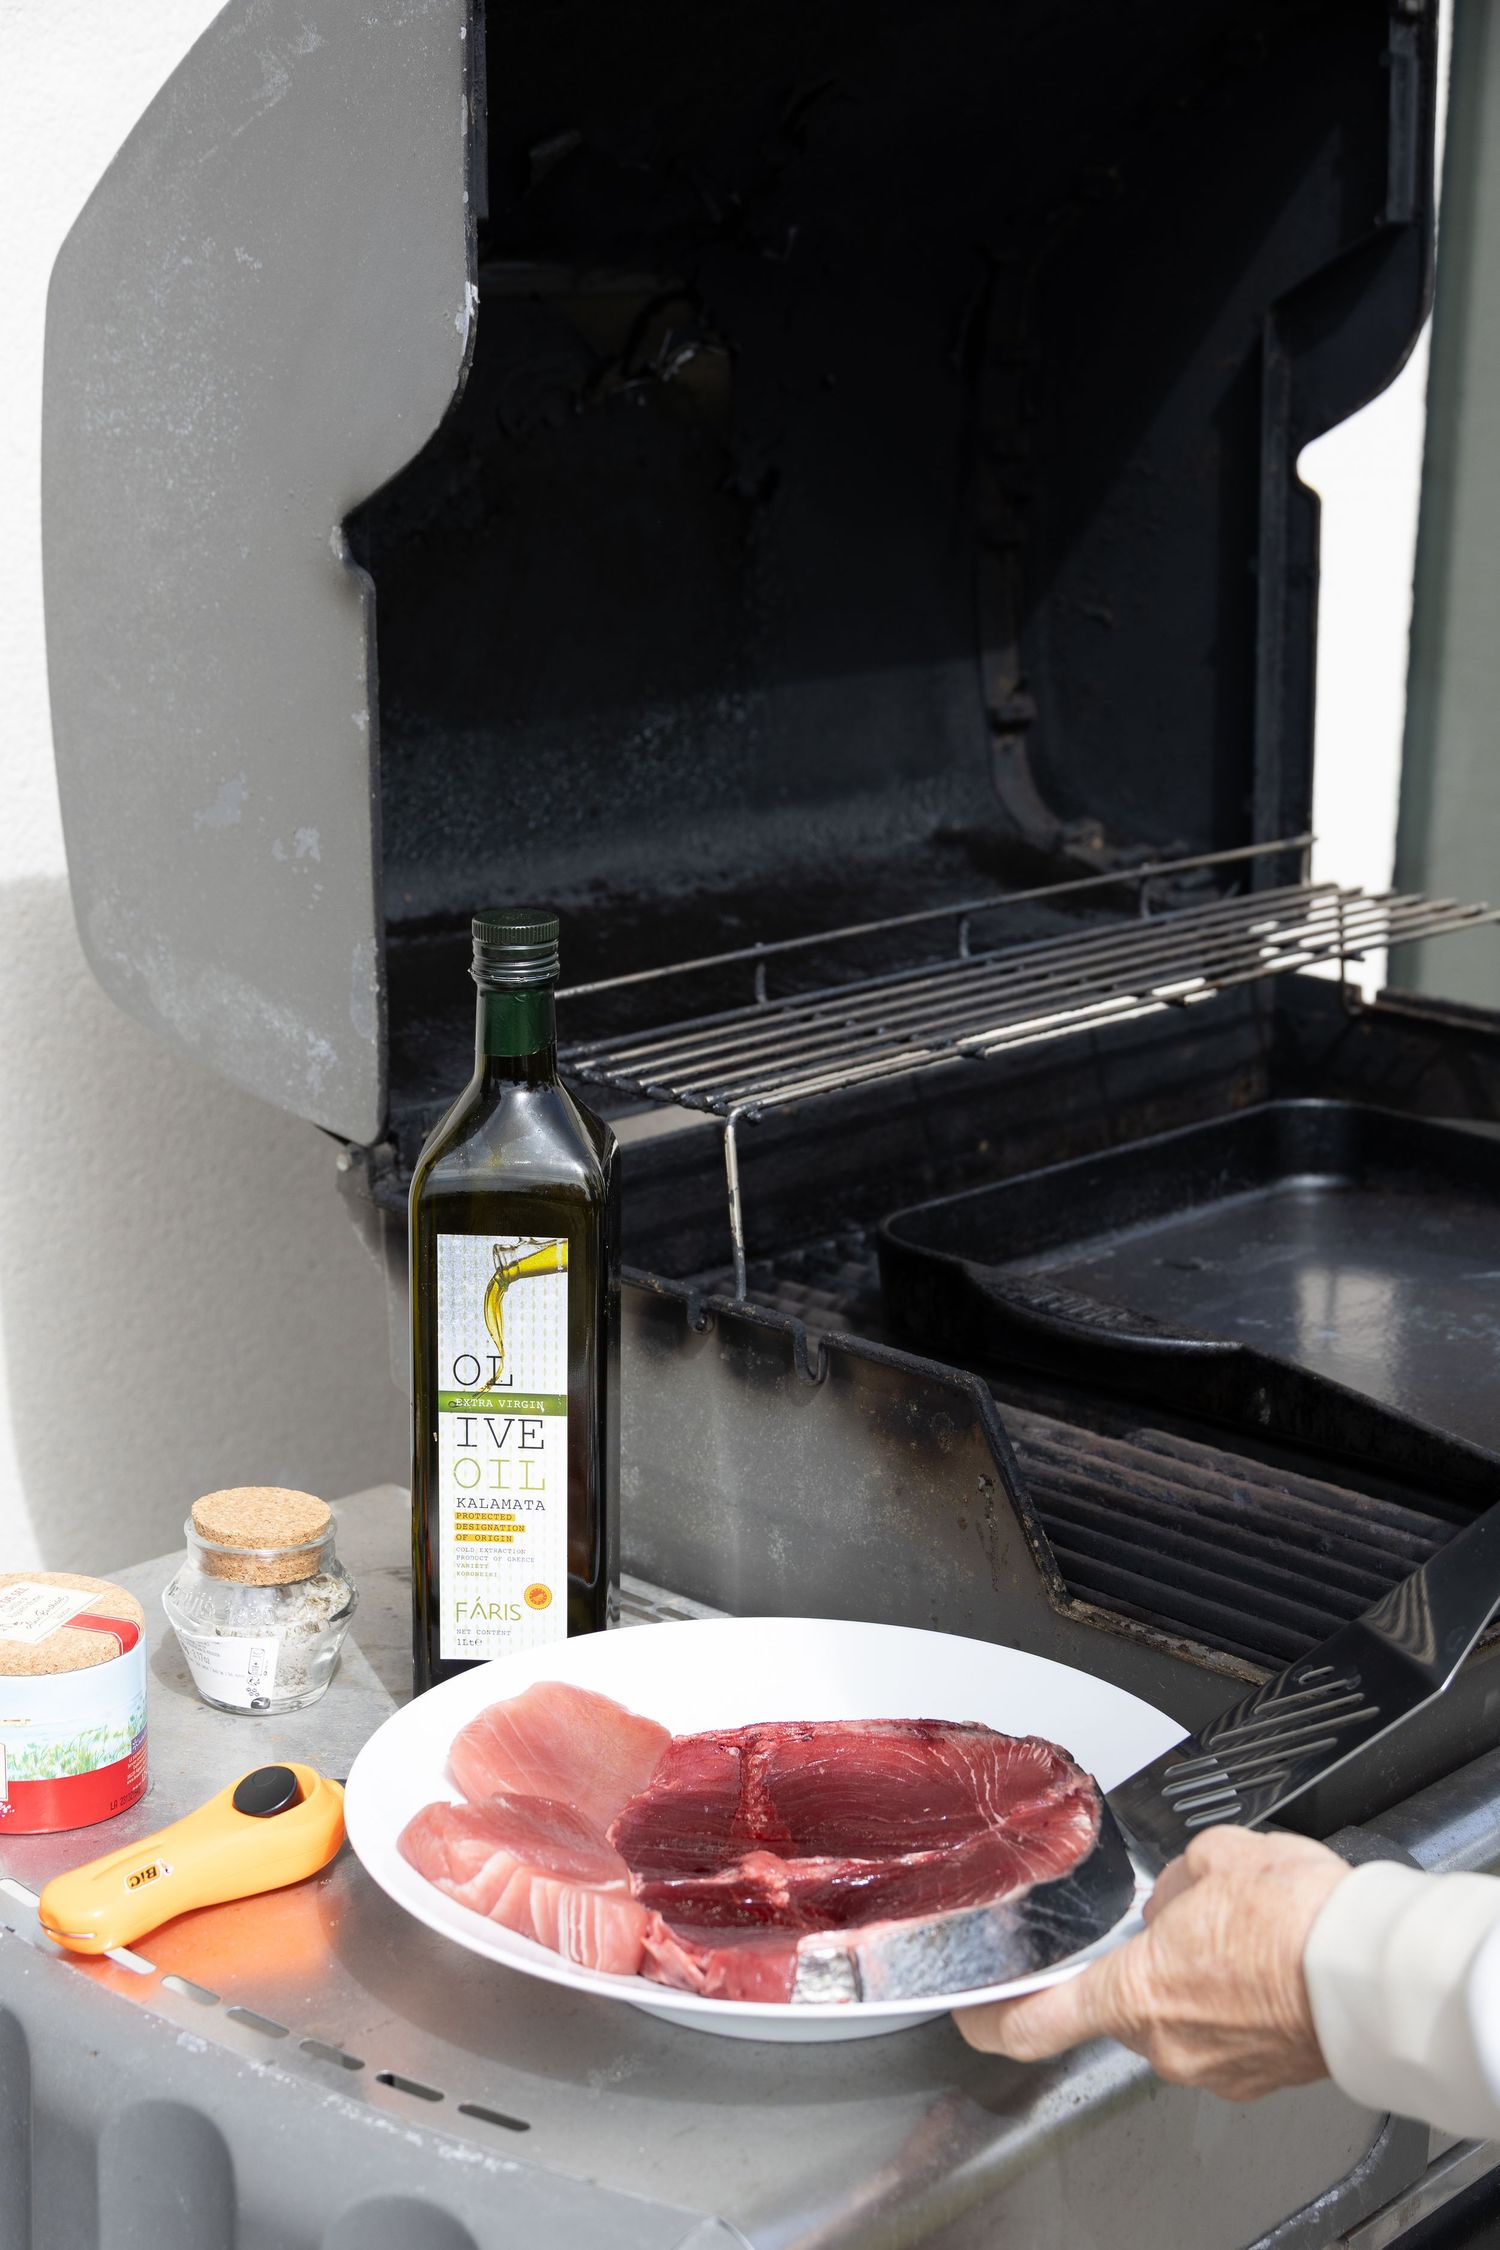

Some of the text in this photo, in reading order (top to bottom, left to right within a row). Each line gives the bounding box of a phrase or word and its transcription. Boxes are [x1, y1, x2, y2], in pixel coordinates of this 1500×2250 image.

[453, 1354, 513, 1386] OL
[455, 1397, 545, 1412] EXTRA VIRGIN
[456, 1416, 545, 1449] IVE
[454, 1457, 545, 1490] OIL
[456, 1497, 546, 1511] KALAMATA
[456, 1512, 513, 1520] PROTECTED
[456, 1523, 525, 1532] DESIGNATION
[474, 1534, 513, 1542] ORIGIN
